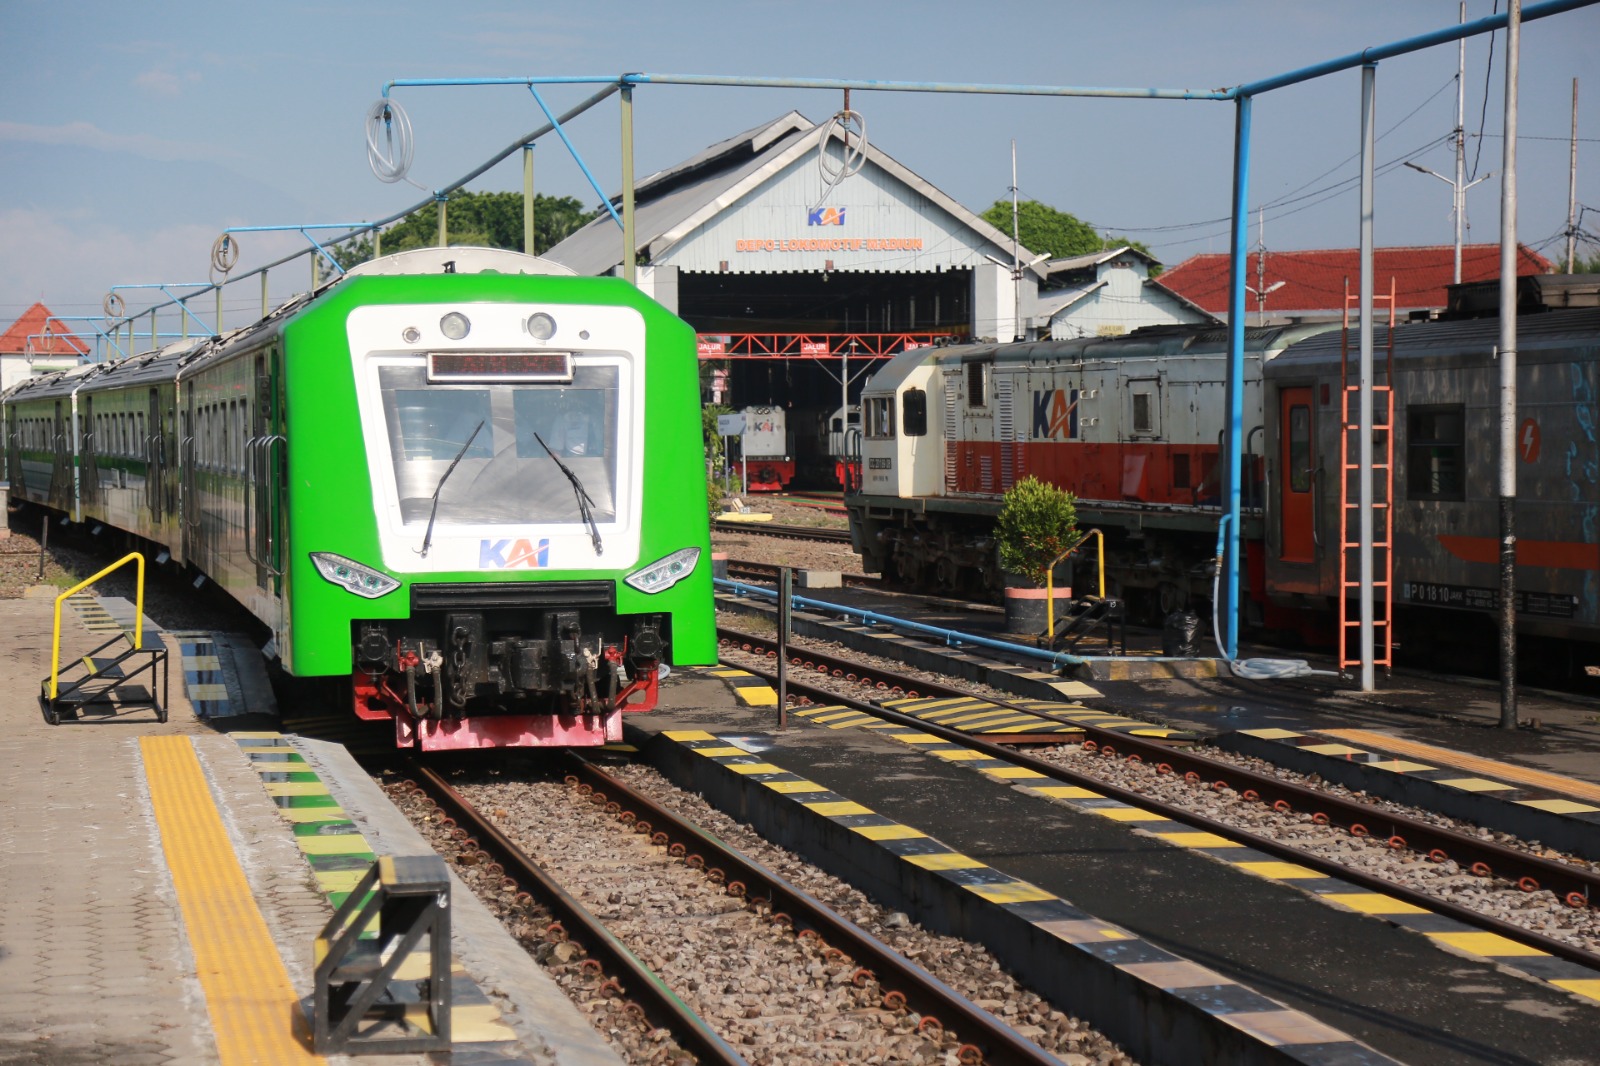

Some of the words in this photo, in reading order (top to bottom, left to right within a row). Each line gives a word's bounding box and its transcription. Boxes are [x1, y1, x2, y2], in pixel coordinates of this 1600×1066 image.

[808, 207, 846, 226] KAI
[736, 239, 775, 252] DEPO
[779, 238, 863, 252] LOKOMOTIF
[866, 238, 923, 251] MADIUN
[1033, 389, 1078, 438] KAI
[754, 421, 774, 433] KAI
[479, 538, 549, 568] KAI
[1411, 584, 1418, 599] P
[1419, 584, 1425, 600] 0
[1426, 585, 1437, 601] 18
[1439, 587, 1449, 602] 10
[436, 892, 447, 909] 16
